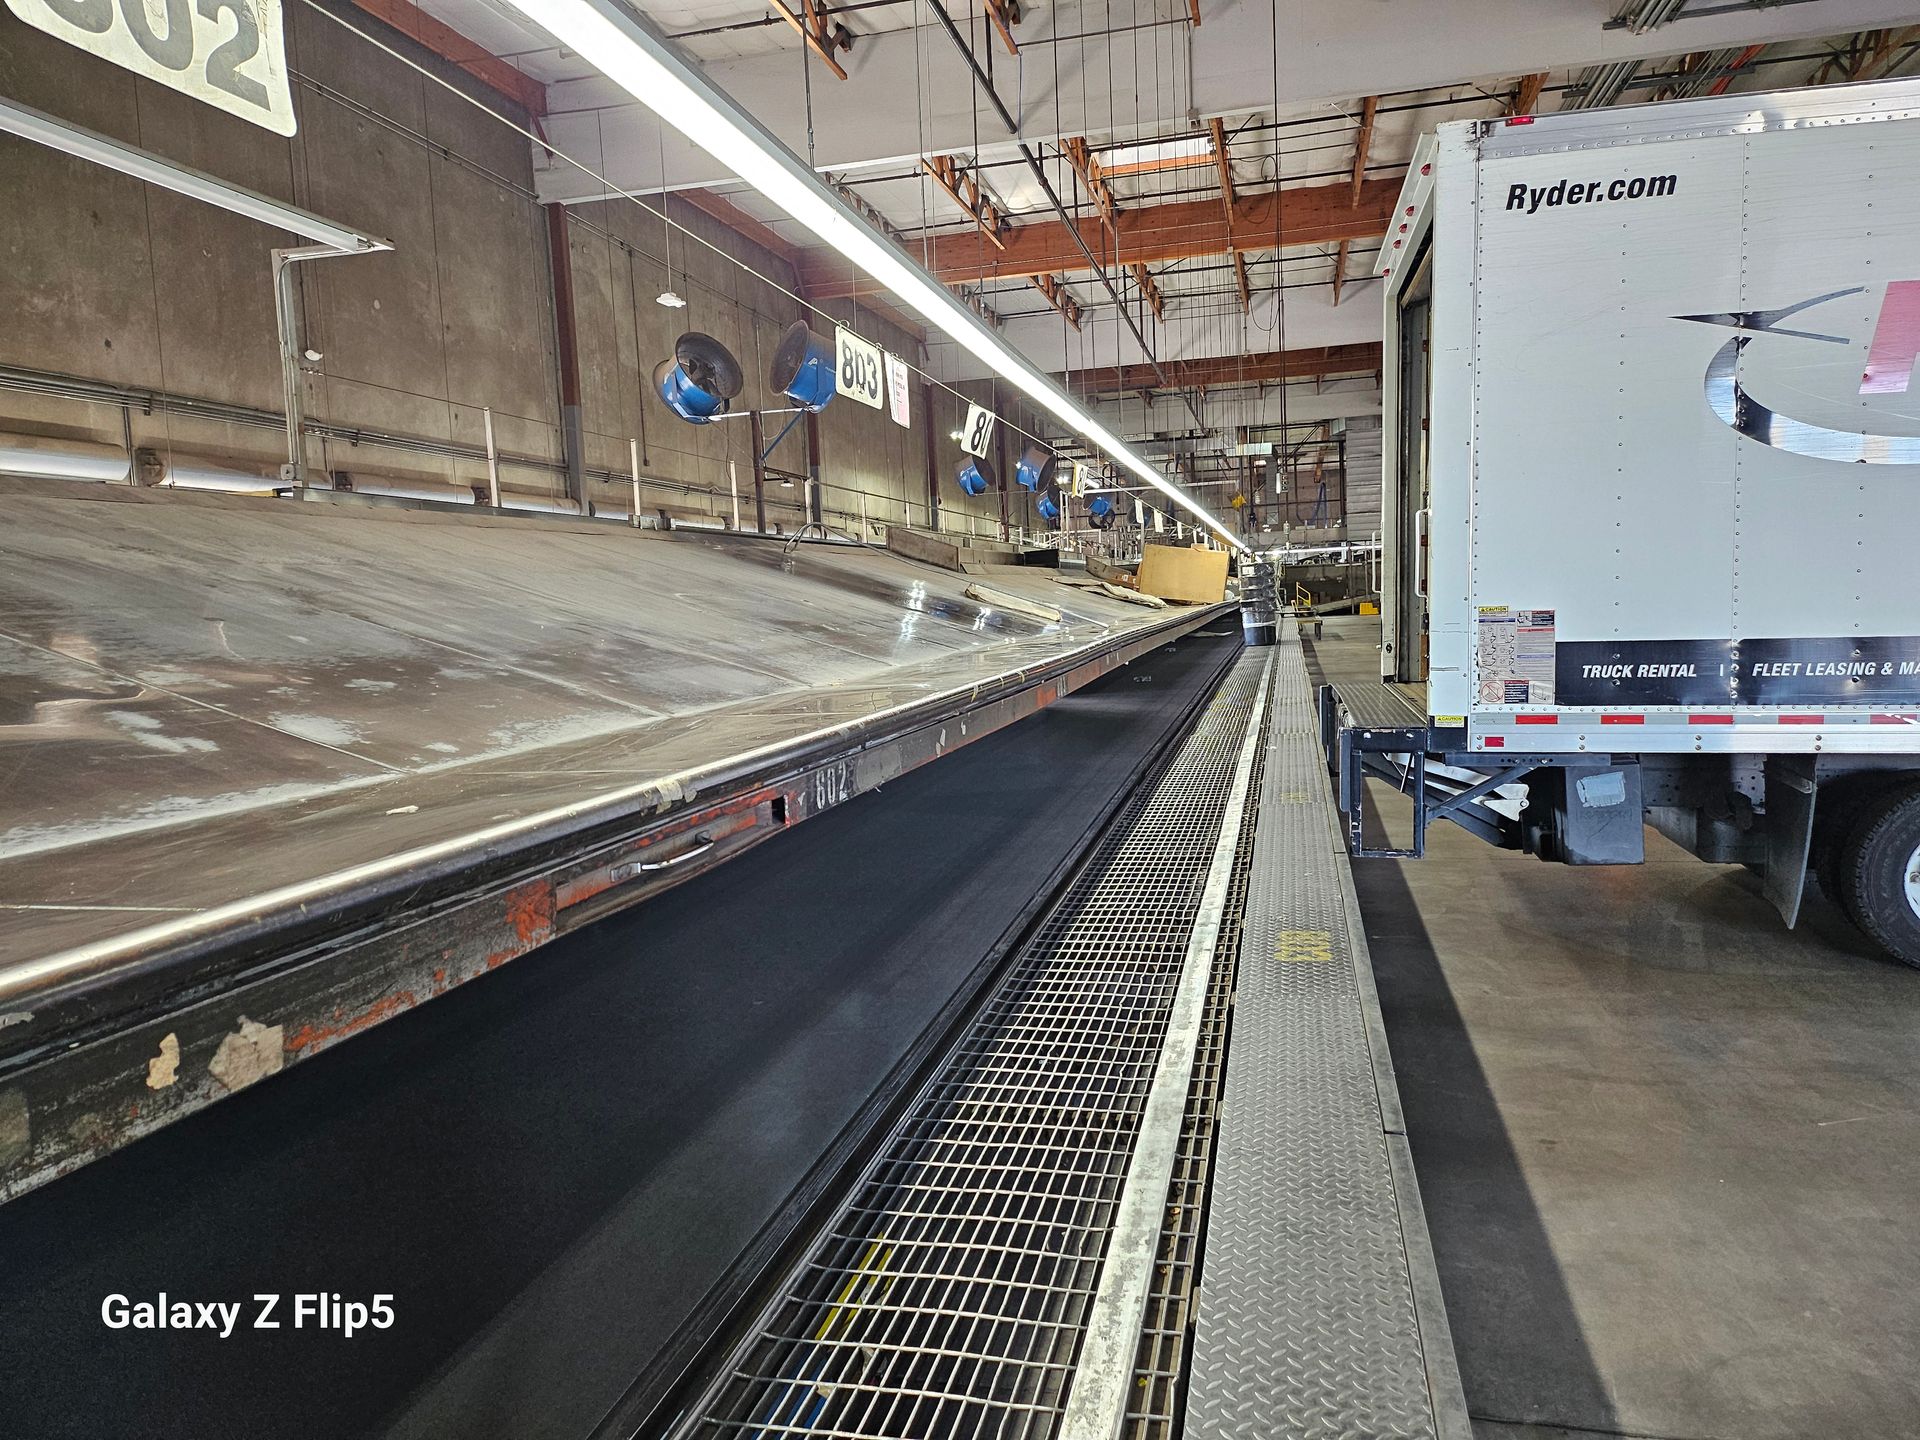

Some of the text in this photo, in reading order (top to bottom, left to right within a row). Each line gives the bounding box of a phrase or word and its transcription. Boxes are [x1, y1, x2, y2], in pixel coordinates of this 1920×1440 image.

[42, 0, 272, 112] 02
[1506, 174, 1677, 214] Ryder.com
[842, 339, 877, 400] 803
[1582, 664, 1634, 678] TRUCK
[1636, 663, 1697, 678] RENTAL
[1752, 662, 1802, 677] FLEET
[1805, 661, 1876, 676] LEASING
[1880, 661, 1893, 676] &
